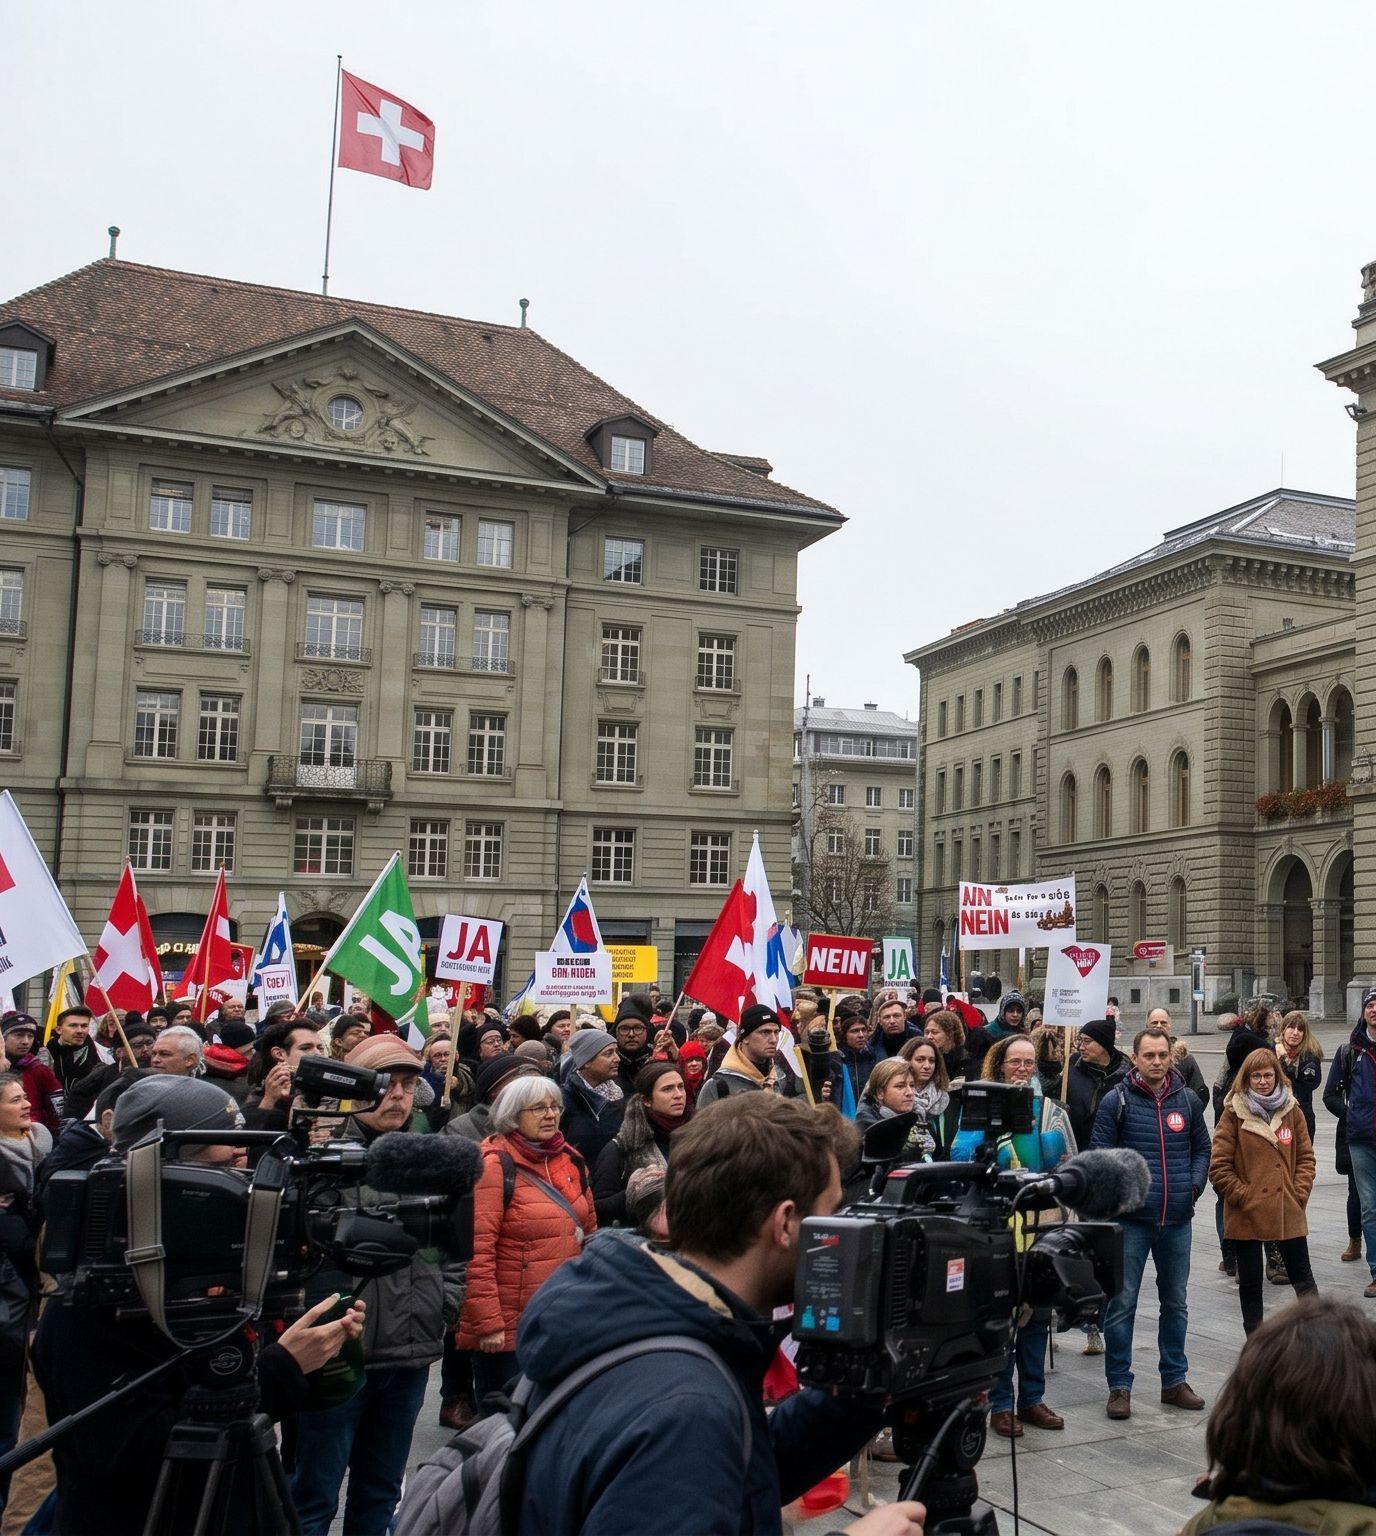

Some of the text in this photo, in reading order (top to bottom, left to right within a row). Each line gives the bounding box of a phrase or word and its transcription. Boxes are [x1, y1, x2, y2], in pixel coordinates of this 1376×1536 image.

[961, 909, 1009, 935] NEIN
[358, 909, 422, 996] JA
[446, 922, 492, 964] JA
[809, 946, 868, 976] NEIN
[887, 949, 911, 980] JA
